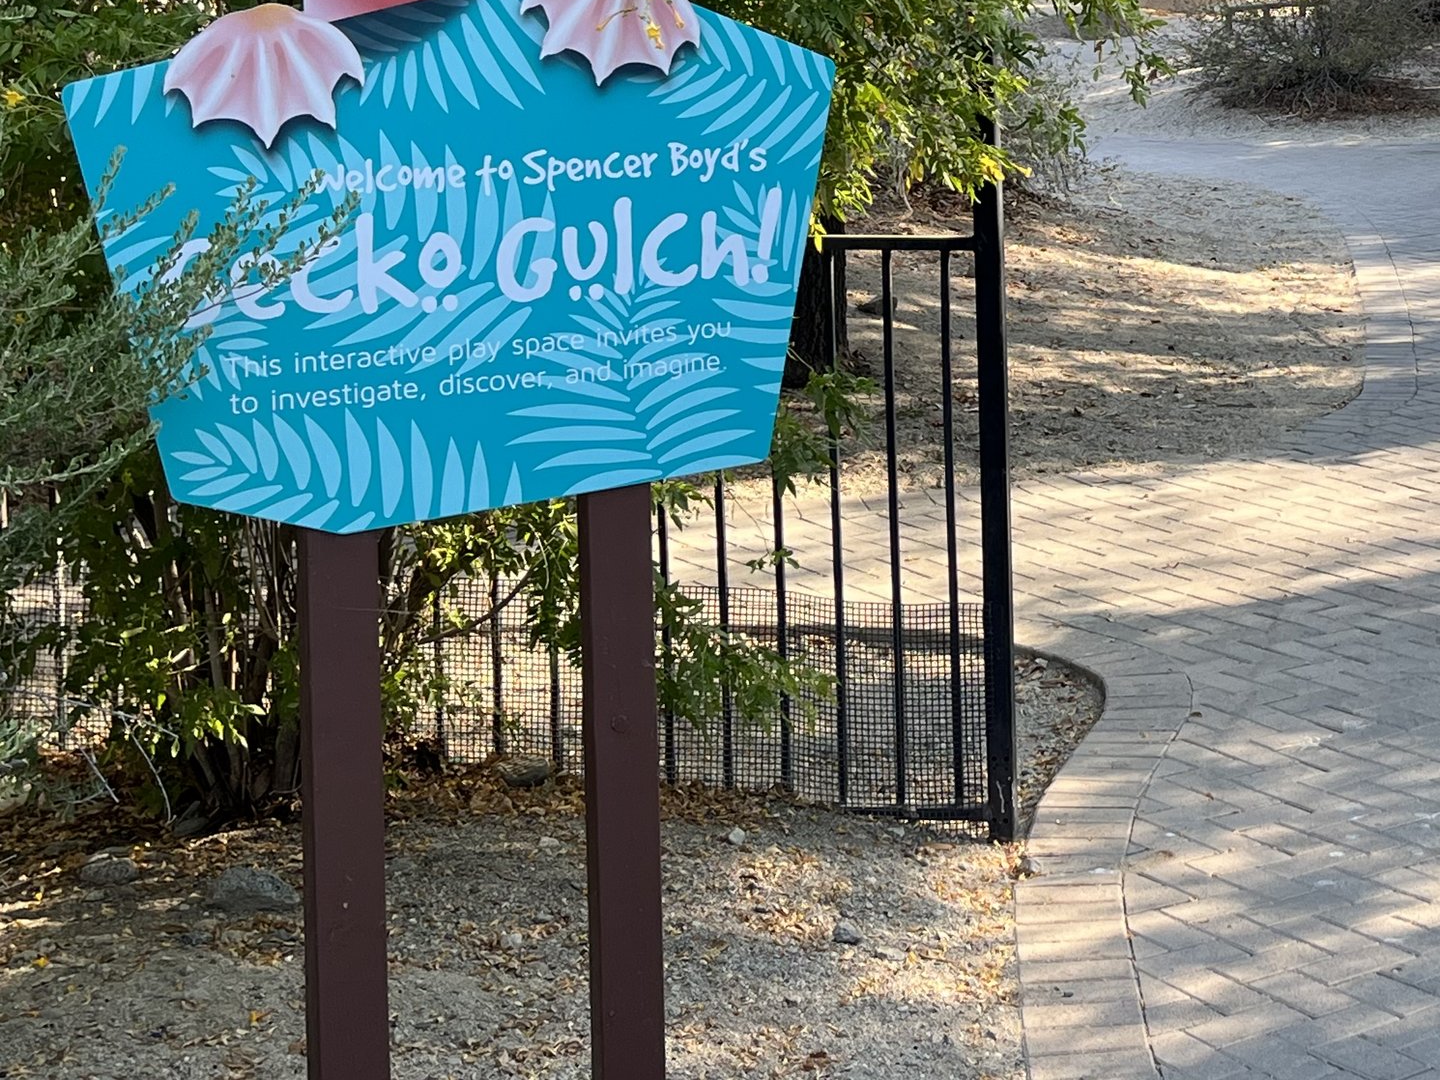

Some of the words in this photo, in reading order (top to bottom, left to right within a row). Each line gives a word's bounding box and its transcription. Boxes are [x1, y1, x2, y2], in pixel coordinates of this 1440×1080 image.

[311, 158, 465, 194] Welcome
[475, 155, 513, 196] to
[522, 149, 658, 192] Spencer
[667, 138, 767, 182] Boyd's
[496, 185, 782, 303] Gulch!
[224, 352, 282, 379] This
[294, 343, 437, 374] interactive
[448, 337, 501, 366] play
[511, 332, 585, 358] space
[597, 323, 677, 348] invites
[687, 320, 732, 346] you
[229, 393, 259, 414] to
[271, 380, 426, 411] investigate,
[439, 369, 552, 396] discover,
[565, 360, 612, 384] and
[623, 354, 728, 380] imagine.
